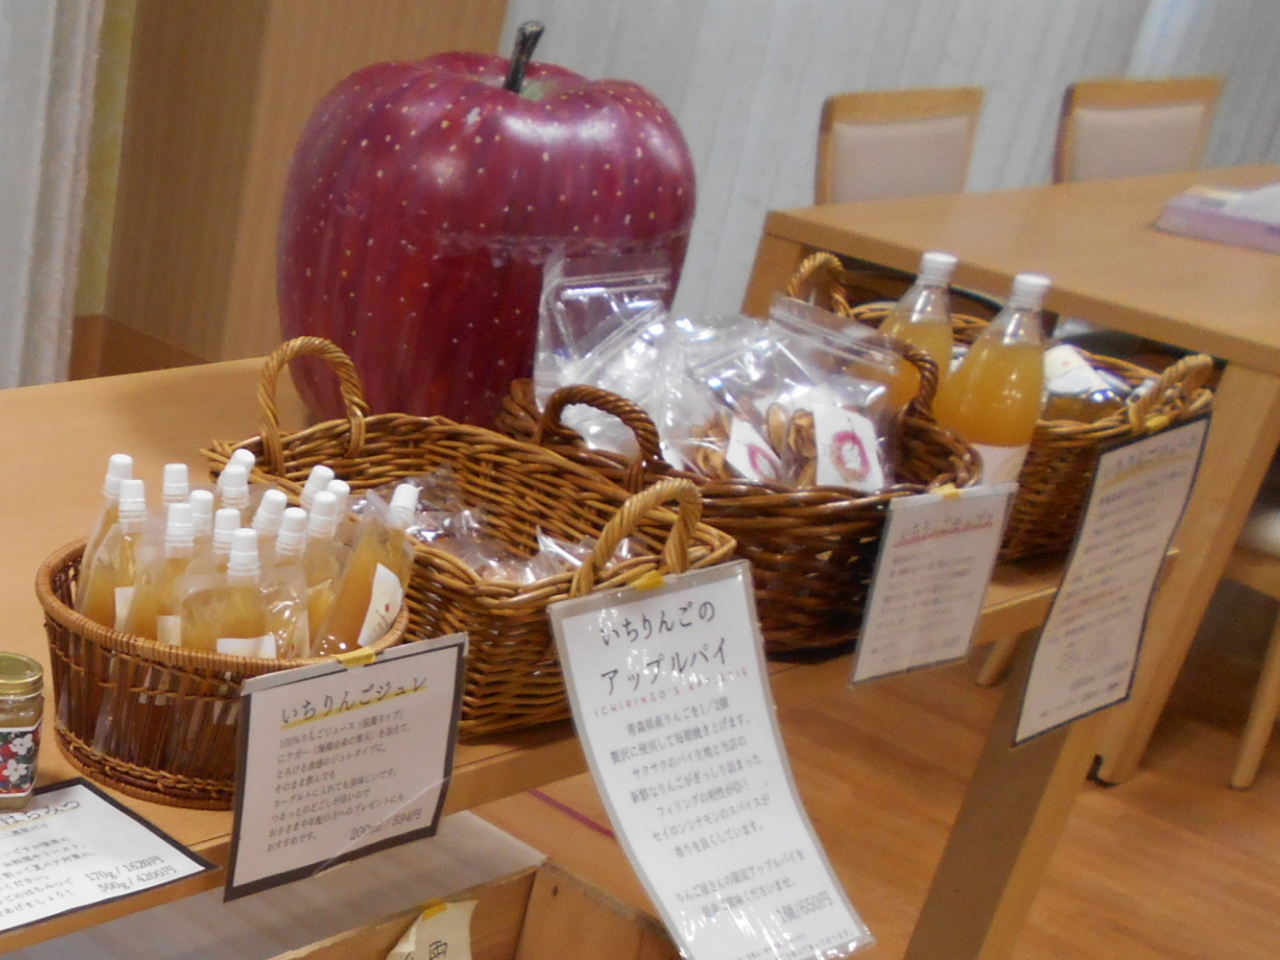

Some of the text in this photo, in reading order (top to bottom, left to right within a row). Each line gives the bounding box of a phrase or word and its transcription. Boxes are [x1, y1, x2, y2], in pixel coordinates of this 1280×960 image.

[600, 600, 715, 648] いちりんごの
[601, 636, 728, 697] アップルパイ
[281, 677, 427, 724] いちりんごジュレ
[84, 870, 118, 881] 170g
[122, 854, 164, 872] 1620円
[97, 880, 131, 892] 500g
[135, 864, 177, 882] 4200円
